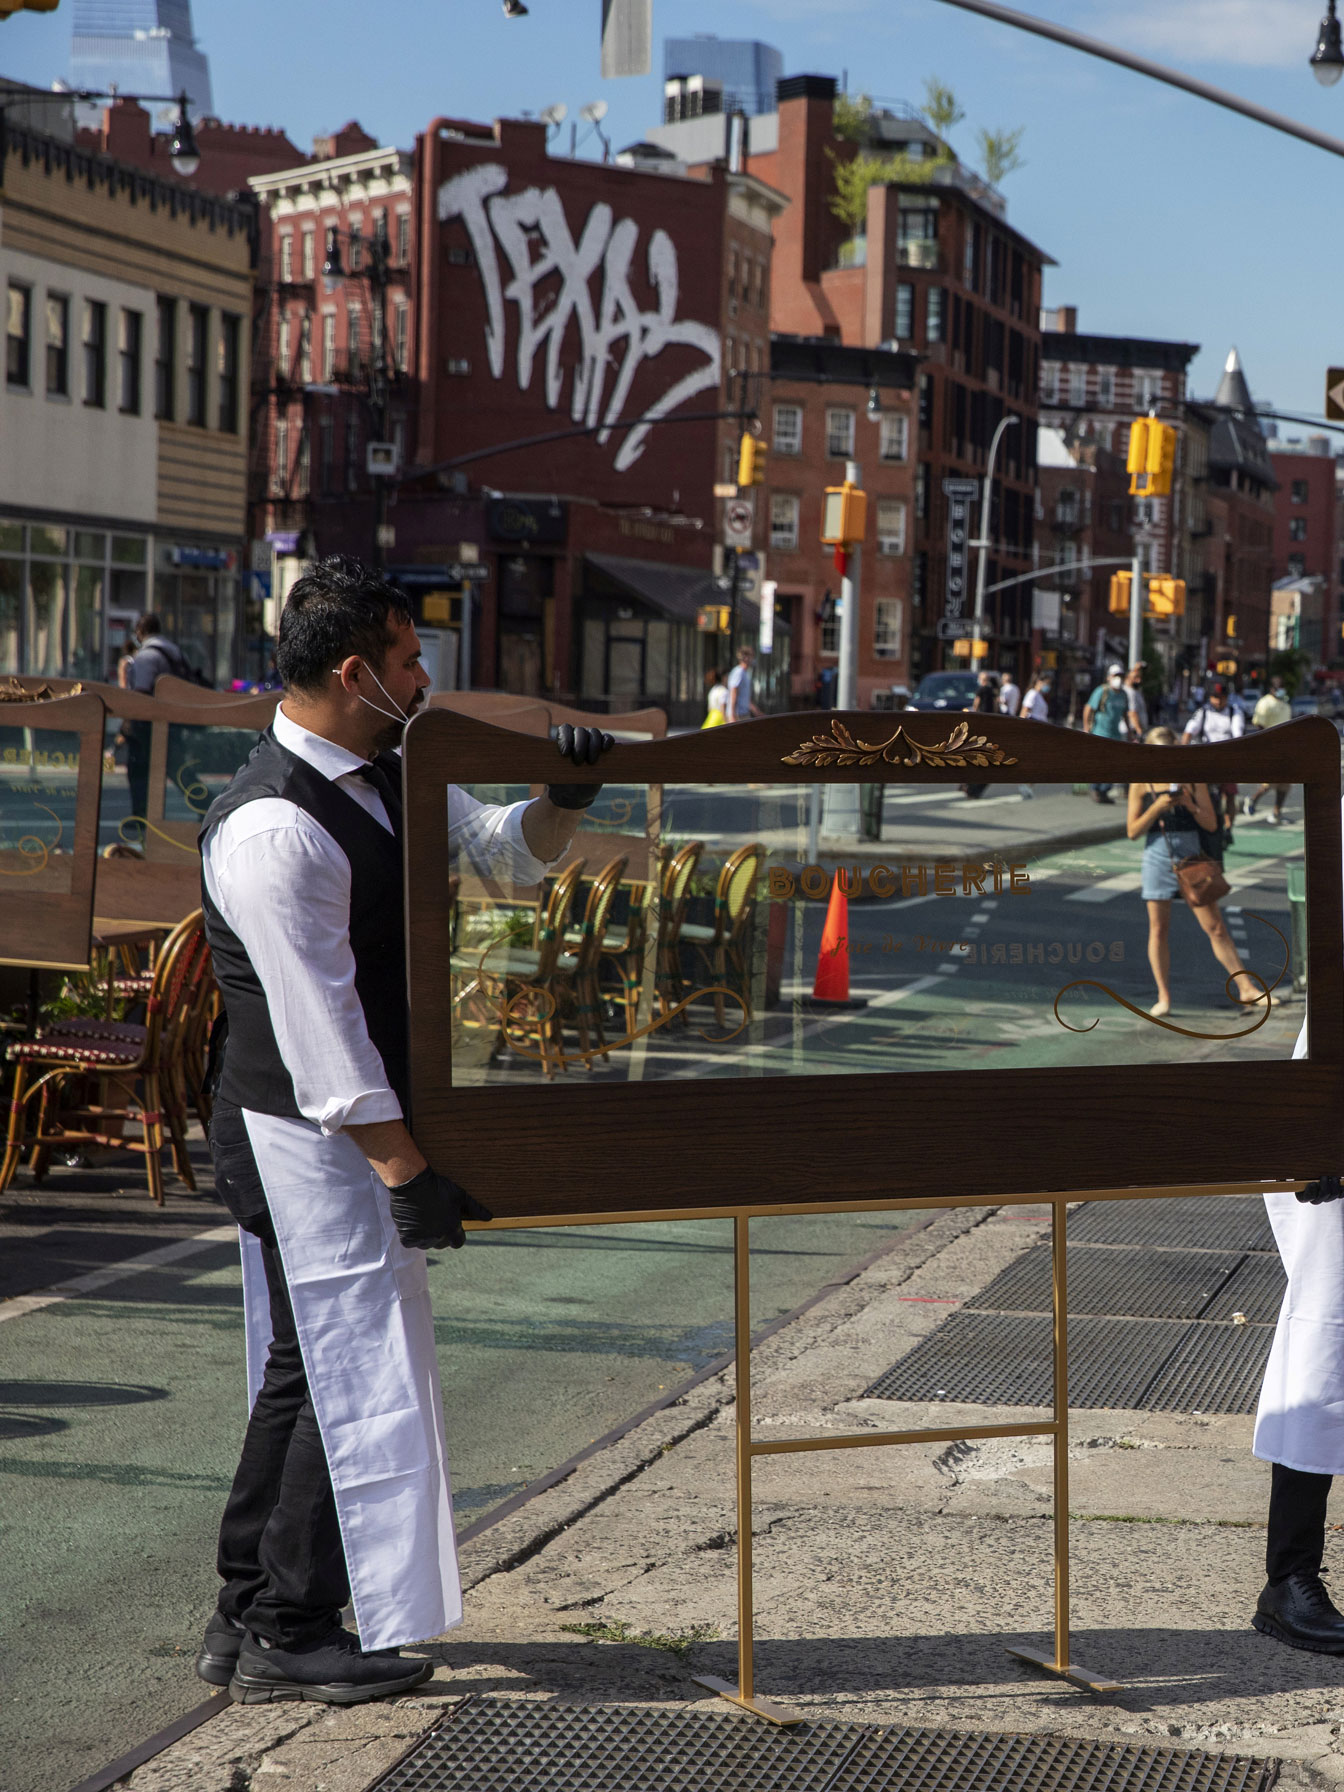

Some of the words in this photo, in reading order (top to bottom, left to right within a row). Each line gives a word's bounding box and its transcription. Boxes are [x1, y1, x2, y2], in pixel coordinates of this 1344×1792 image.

[769, 863, 1032, 899] BOUCHERIE
[830, 936, 873, 957] Joie
[881, 934, 904, 953] de
[912, 935, 969, 953] Vivre
